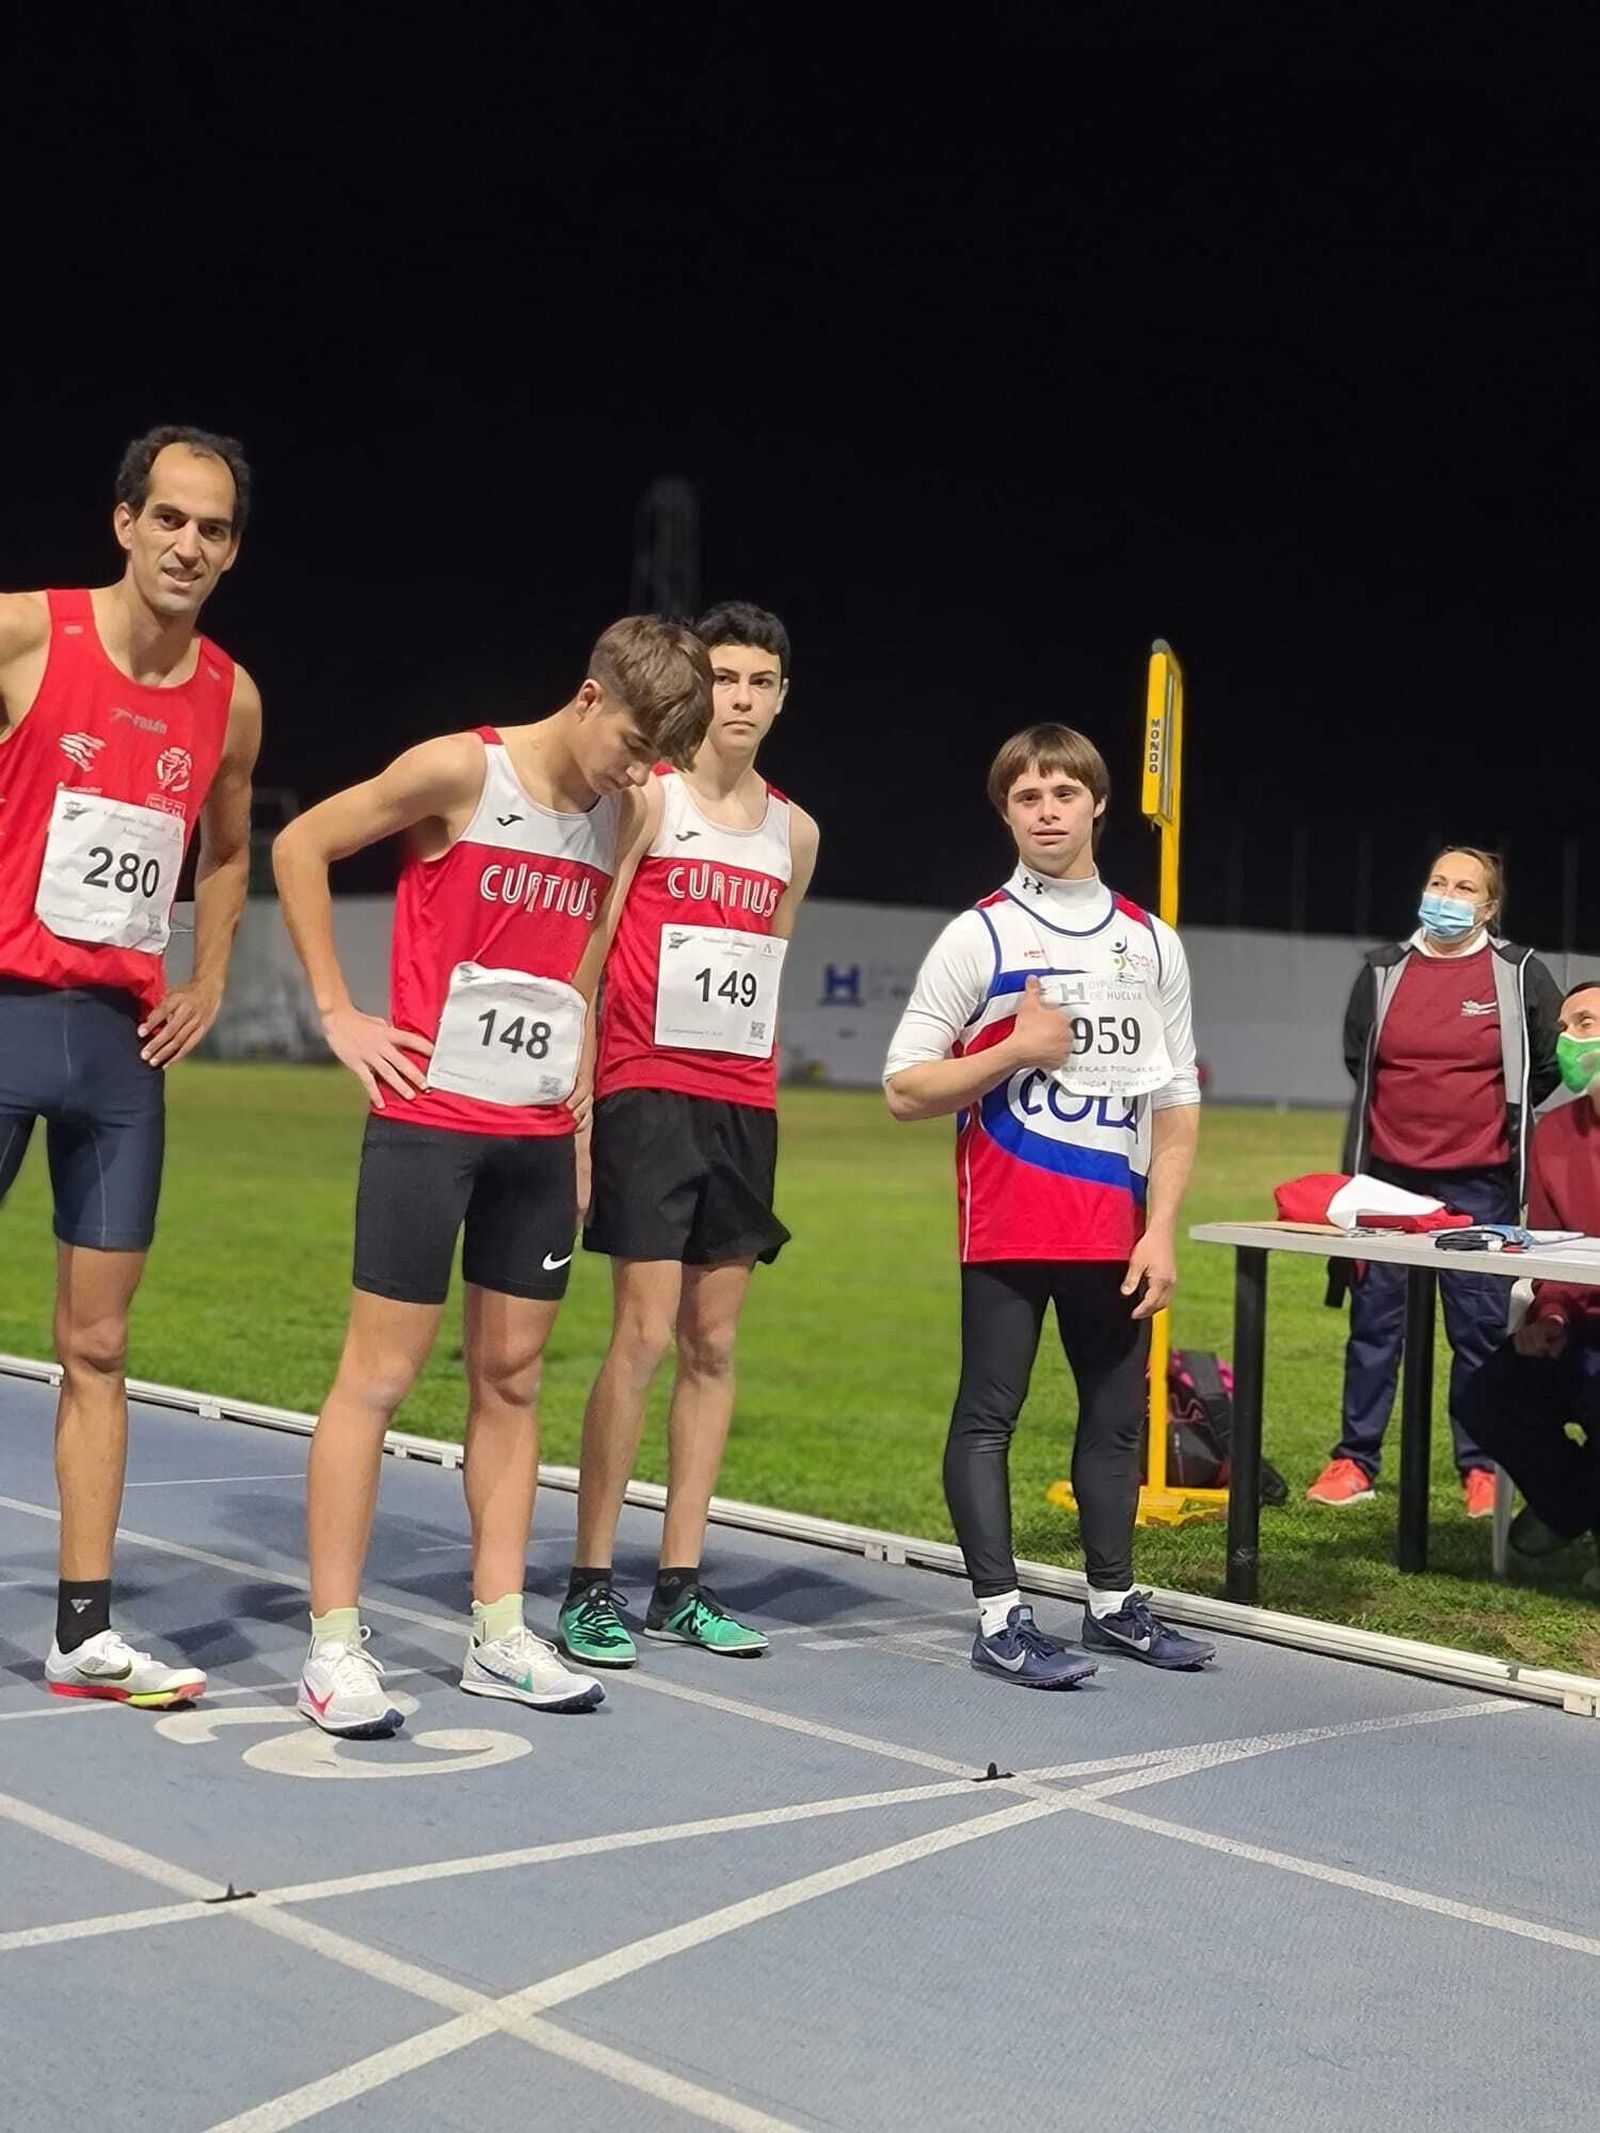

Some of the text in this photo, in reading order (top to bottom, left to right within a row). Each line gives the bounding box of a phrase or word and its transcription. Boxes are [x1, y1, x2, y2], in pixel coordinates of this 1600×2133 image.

[1149, 719, 1161, 774] MONDO
[82, 846, 160, 899] 280
[480, 863, 597, 921] CURTIUS
[667, 863, 778, 918] CURTIUS
[695, 967, 757, 1008] 149
[1106, 991, 1143, 1001] HUELVA
[478, 1009, 551, 1060] 148
[1070, 1016, 1142, 1056] 959
